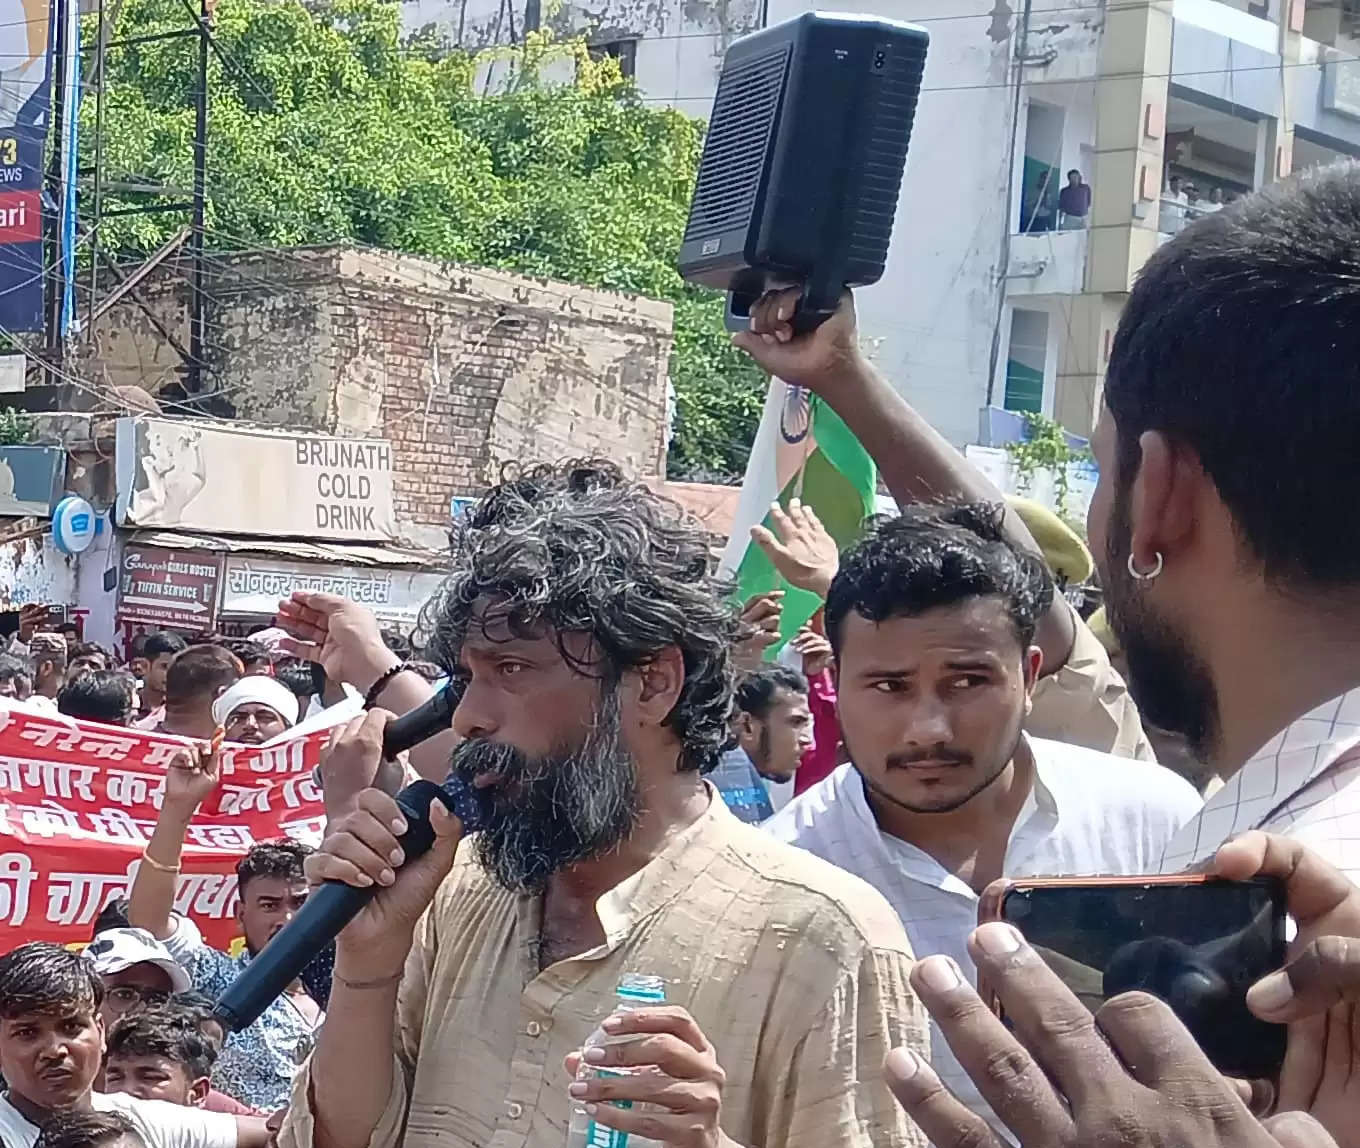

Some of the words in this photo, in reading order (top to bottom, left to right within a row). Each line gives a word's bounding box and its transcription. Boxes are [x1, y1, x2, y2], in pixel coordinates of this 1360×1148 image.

[296, 440, 390, 470] BRIJNATH
[317, 473, 371, 499] COLD
[316, 503, 375, 530] DRINK
[163, 584, 198, 599] SERVICE
[230, 563, 291, 596] सोनकर
